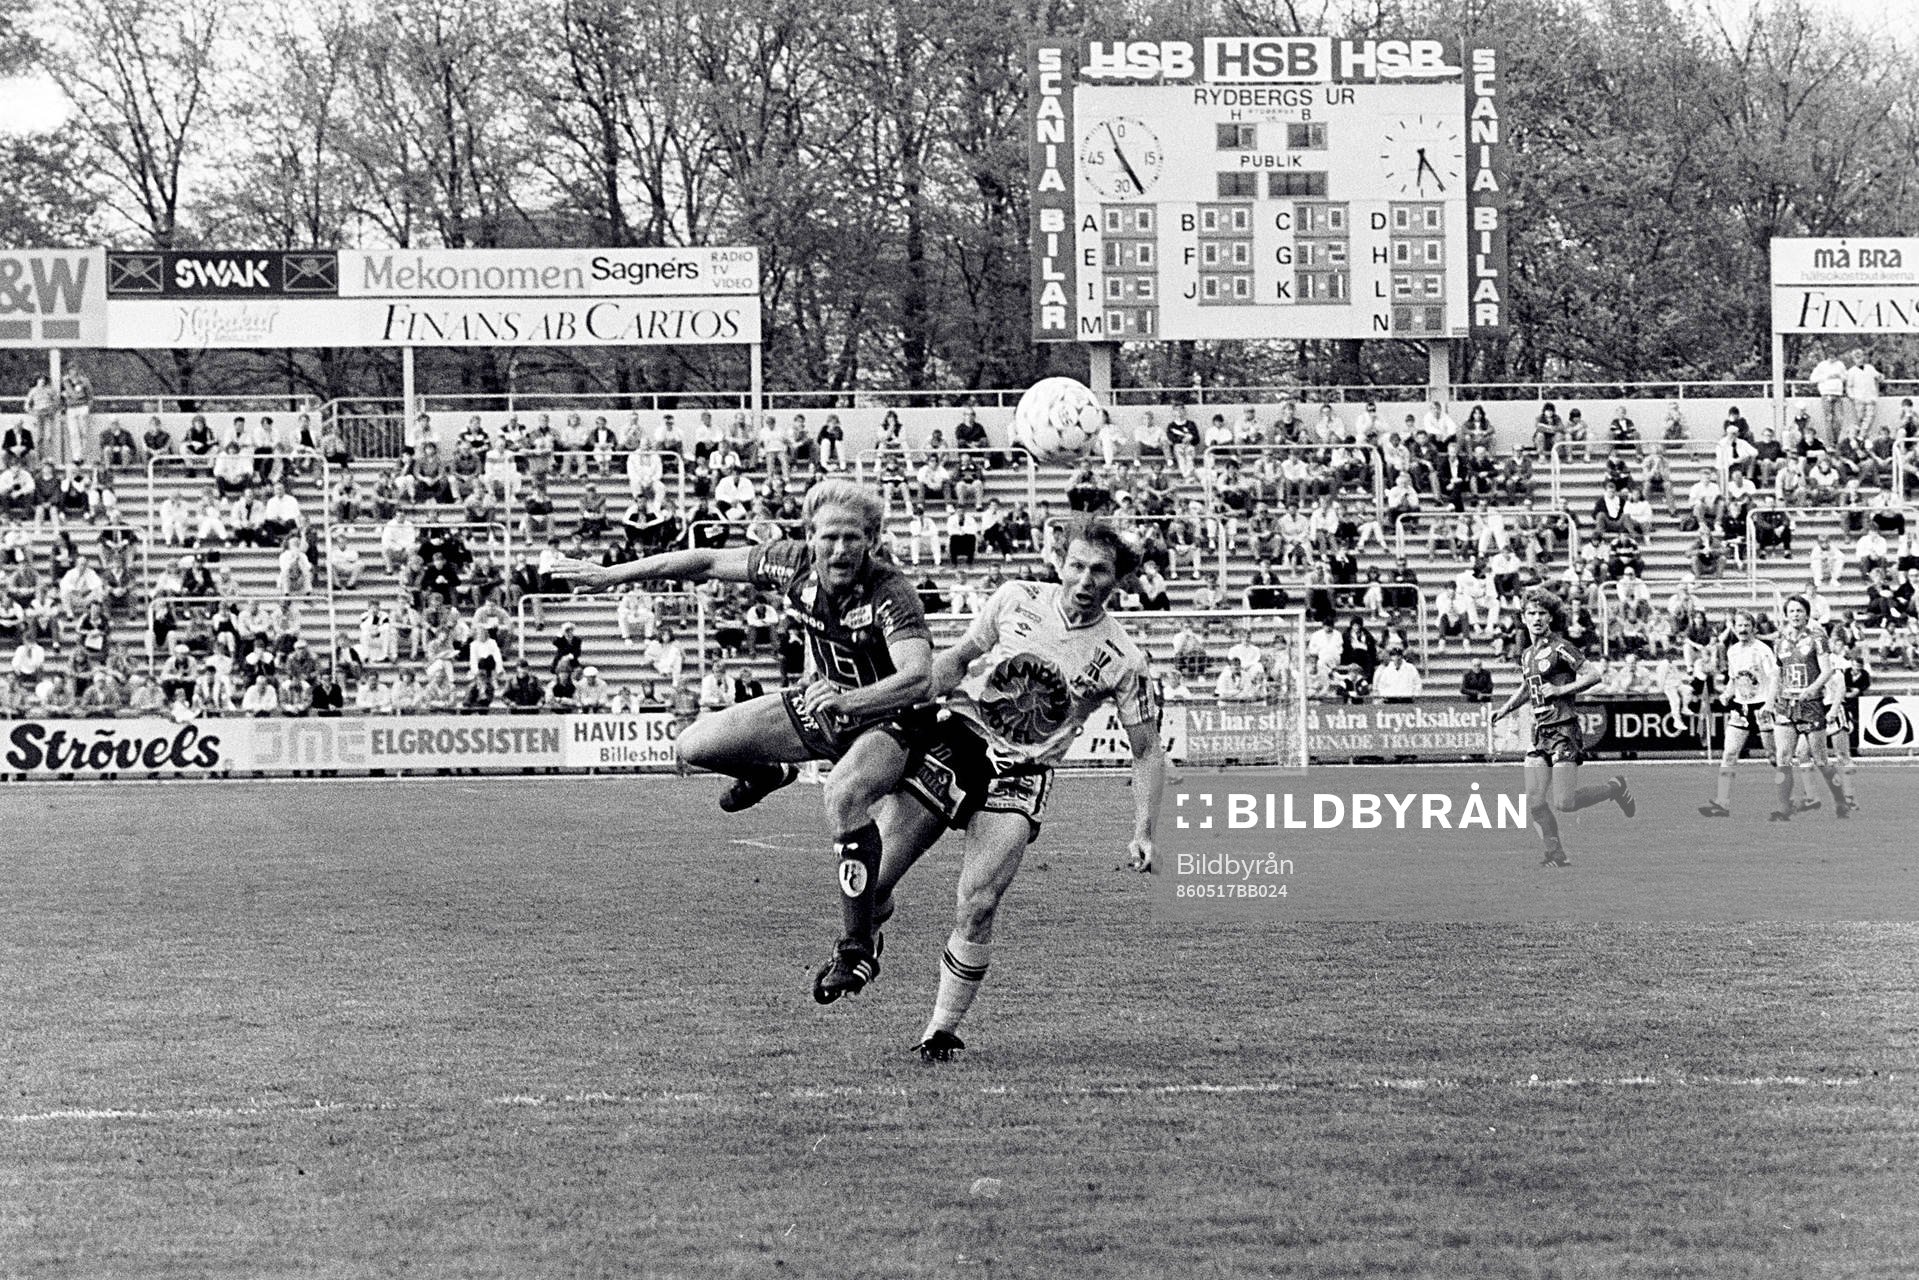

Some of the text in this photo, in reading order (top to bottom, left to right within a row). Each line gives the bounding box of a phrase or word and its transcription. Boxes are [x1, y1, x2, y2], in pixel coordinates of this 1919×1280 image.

[1089, 41, 1195, 79] HSB
[1216, 42, 1318, 77] HSB
[1340, 40, 1444, 79] HSB
[1194, 88, 1356, 106] RYDBERGS UR
[1231, 109, 1242, 121] H
[1302, 108, 1312, 121] B
[1117, 124, 1126, 138] 0
[1087, 151, 1105, 165] 45
[1144, 151, 1156, 165] 15
[1240, 154, 1303, 168] PUBLIK
[1037, 48, 1067, 329] SCANIA BILAR
[1114, 179, 1131, 193] 30
[1470, 48, 1500, 327] SCANIA BILAR
[1082, 214, 1098, 232] A
[1181, 213, 1195, 231] B
[1275, 212, 1291, 230] C
[1371, 213, 1387, 230] D
[711, 252, 754, 262] RADIO
[1084, 248, 1096, 266] E
[1184, 247, 1196, 265] F
[1276, 247, 1292, 264] G
[1373, 247, 1388, 264] H
[174, 258, 270, 289] SWAK
[363, 256, 699, 290] Mekonomen Sagnérs
[713, 265, 728, 275] TV
[712, 278, 753, 289] VIDEO
[1088, 282, 1095, 300] I
[1184, 282, 1197, 299] J
[1277, 281, 1291, 298] K
[1375, 281, 1386, 298] L
[381, 302, 741, 341] FINANS AB CARTOS
[1081, 316, 1102, 334] M
[1373, 314, 1389, 331] N
[1189, 710, 1213, 731] Vi
[1220, 710, 1254, 731] har
[1325, 709, 1368, 729] våra
[1376, 706, 1487, 732] trycksaker!
[574, 721, 638, 742] HAVIS
[371, 728, 560, 754] ELGROSSISTEN
[600, 745, 674, 763] Billeshol
